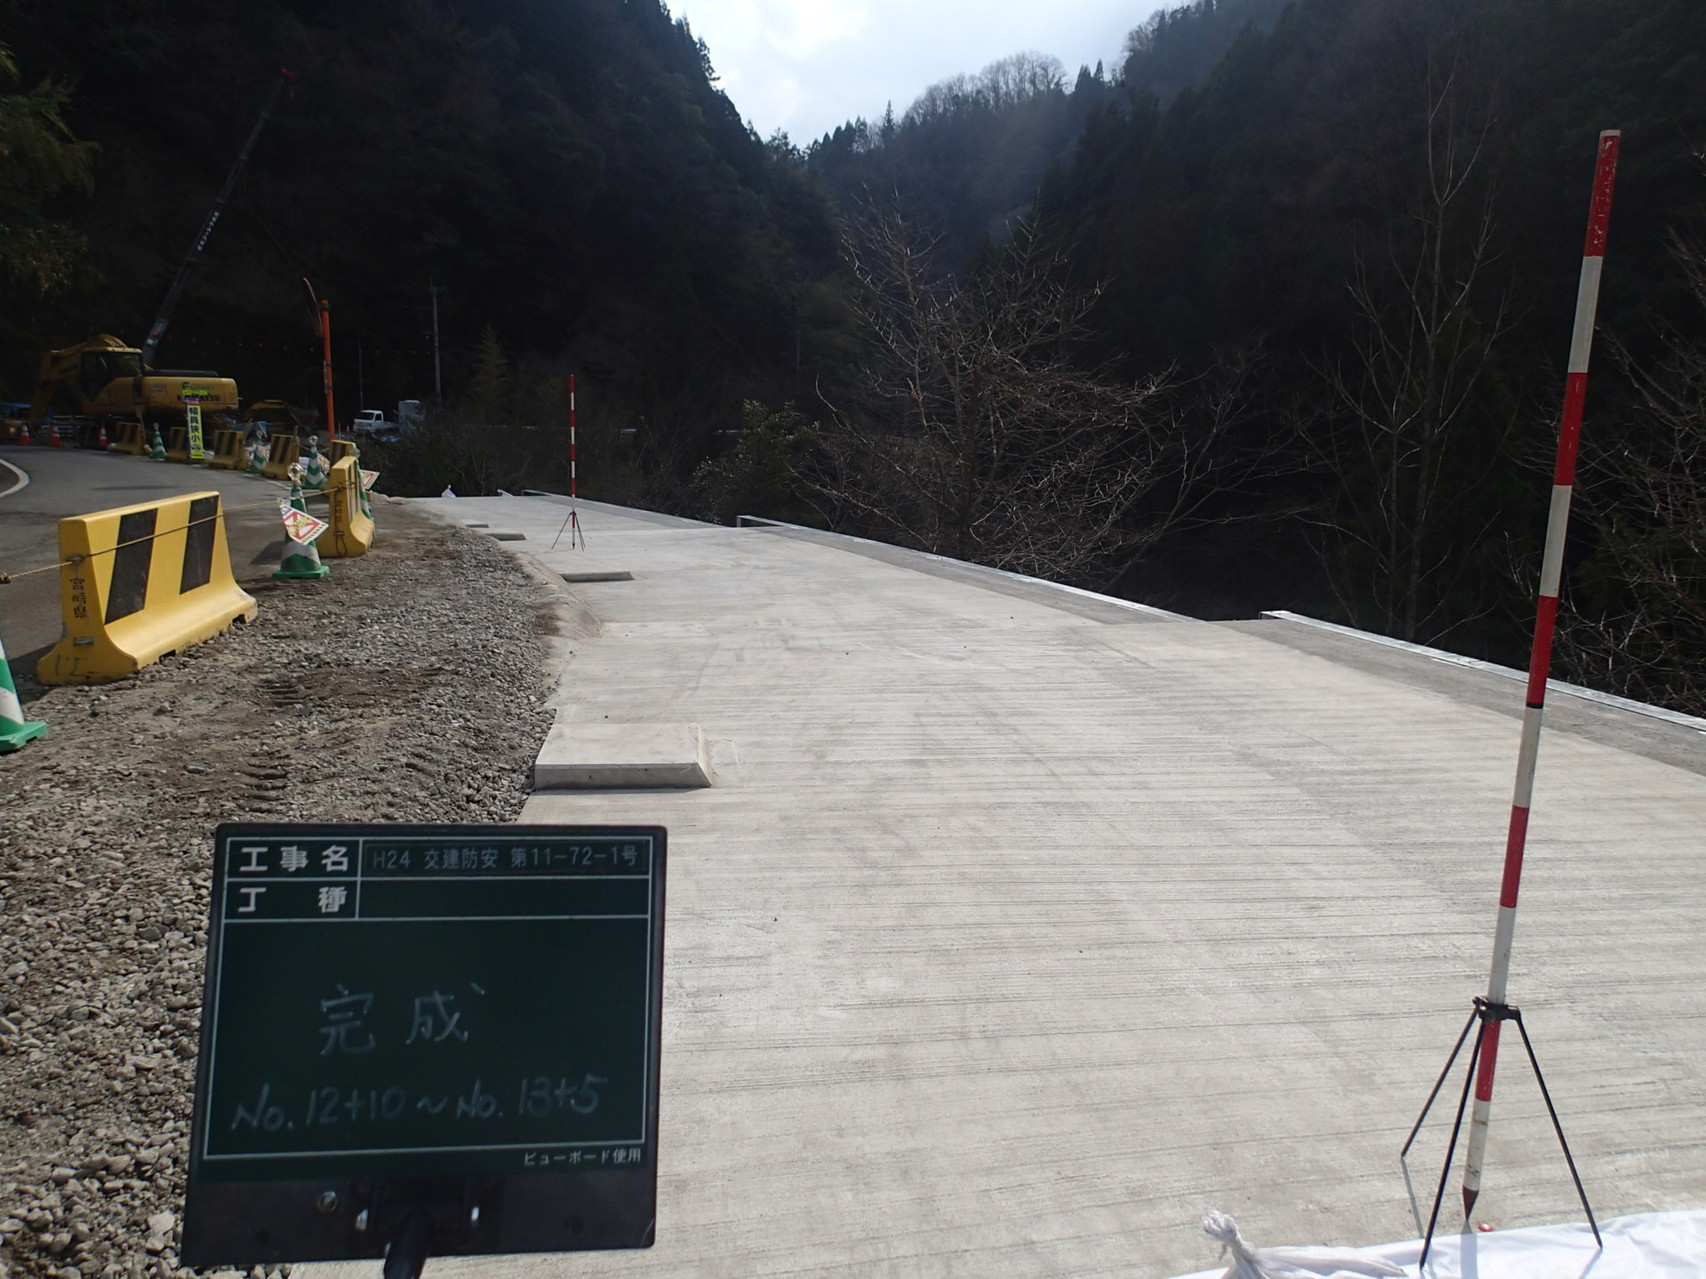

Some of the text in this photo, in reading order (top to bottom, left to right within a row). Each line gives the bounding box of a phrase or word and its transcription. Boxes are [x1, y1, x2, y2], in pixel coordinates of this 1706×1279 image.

[240, 845, 349, 872] 工事名
[373, 849, 411, 869] H24
[424, 847, 498, 870] 交建防安
[319, 982, 486, 1055] 完成
[524, 1148, 642, 1166] ビューボード使用
